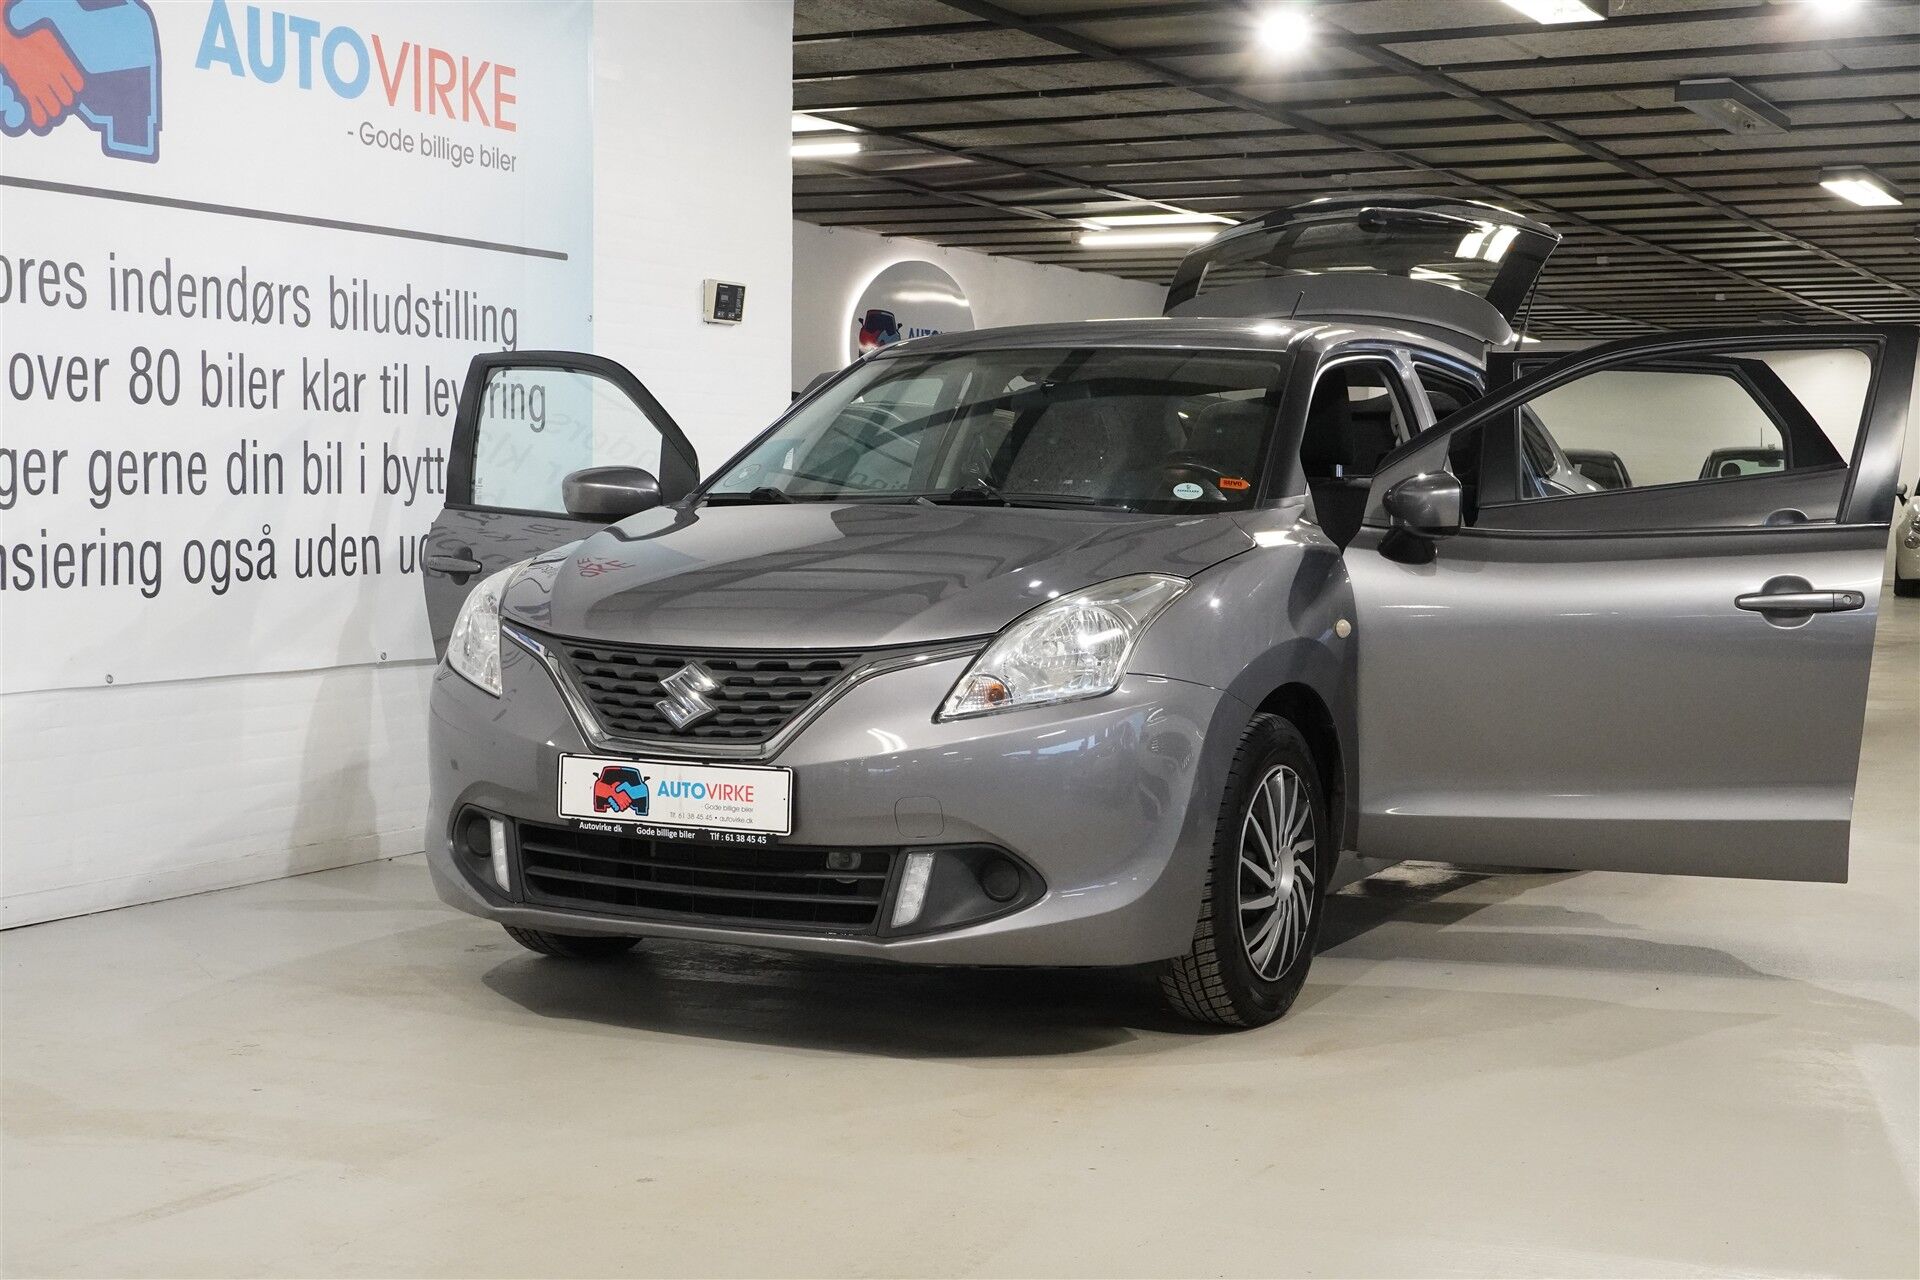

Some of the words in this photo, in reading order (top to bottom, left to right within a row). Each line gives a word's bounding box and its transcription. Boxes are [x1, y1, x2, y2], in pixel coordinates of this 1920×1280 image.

[195, 0, 517, 133] AUTOVIRKE
[359, 121, 414, 153] Gode
[420, 132, 474, 168] billige
[479, 145, 517, 173] biler
[109, 252, 311, 329] indendørs
[329, 275, 519, 352] biludstilling
[9, 352, 109, 402] over
[129, 346, 181, 406] 80
[201, 350, 285, 408] biler
[302, 357, 366, 413] klar
[380, 363, 408, 415] til
[0, 448, 68, 510] ger
[88, 448, 208, 509] gerne
[227, 439, 284, 496] din
[302, 441, 342, 495] bil
[361, 442, 366, 495] i
[384, 442, 447, 506] bytt
[183, 524, 277, 595] også
[295, 523, 381, 578] uden
[657, 780, 754, 802] AUTOVIRKE
[704, 803, 721, 811] Gode
[636, 826, 655, 835] Gode
[656, 828, 678, 839] billige
[679, 830, 695, 838] biler
[725, 833, 734, 842] 61
[736, 834, 745, 843] 38
[746, 835, 756, 843] 45
[757, 836, 767, 844] 45
